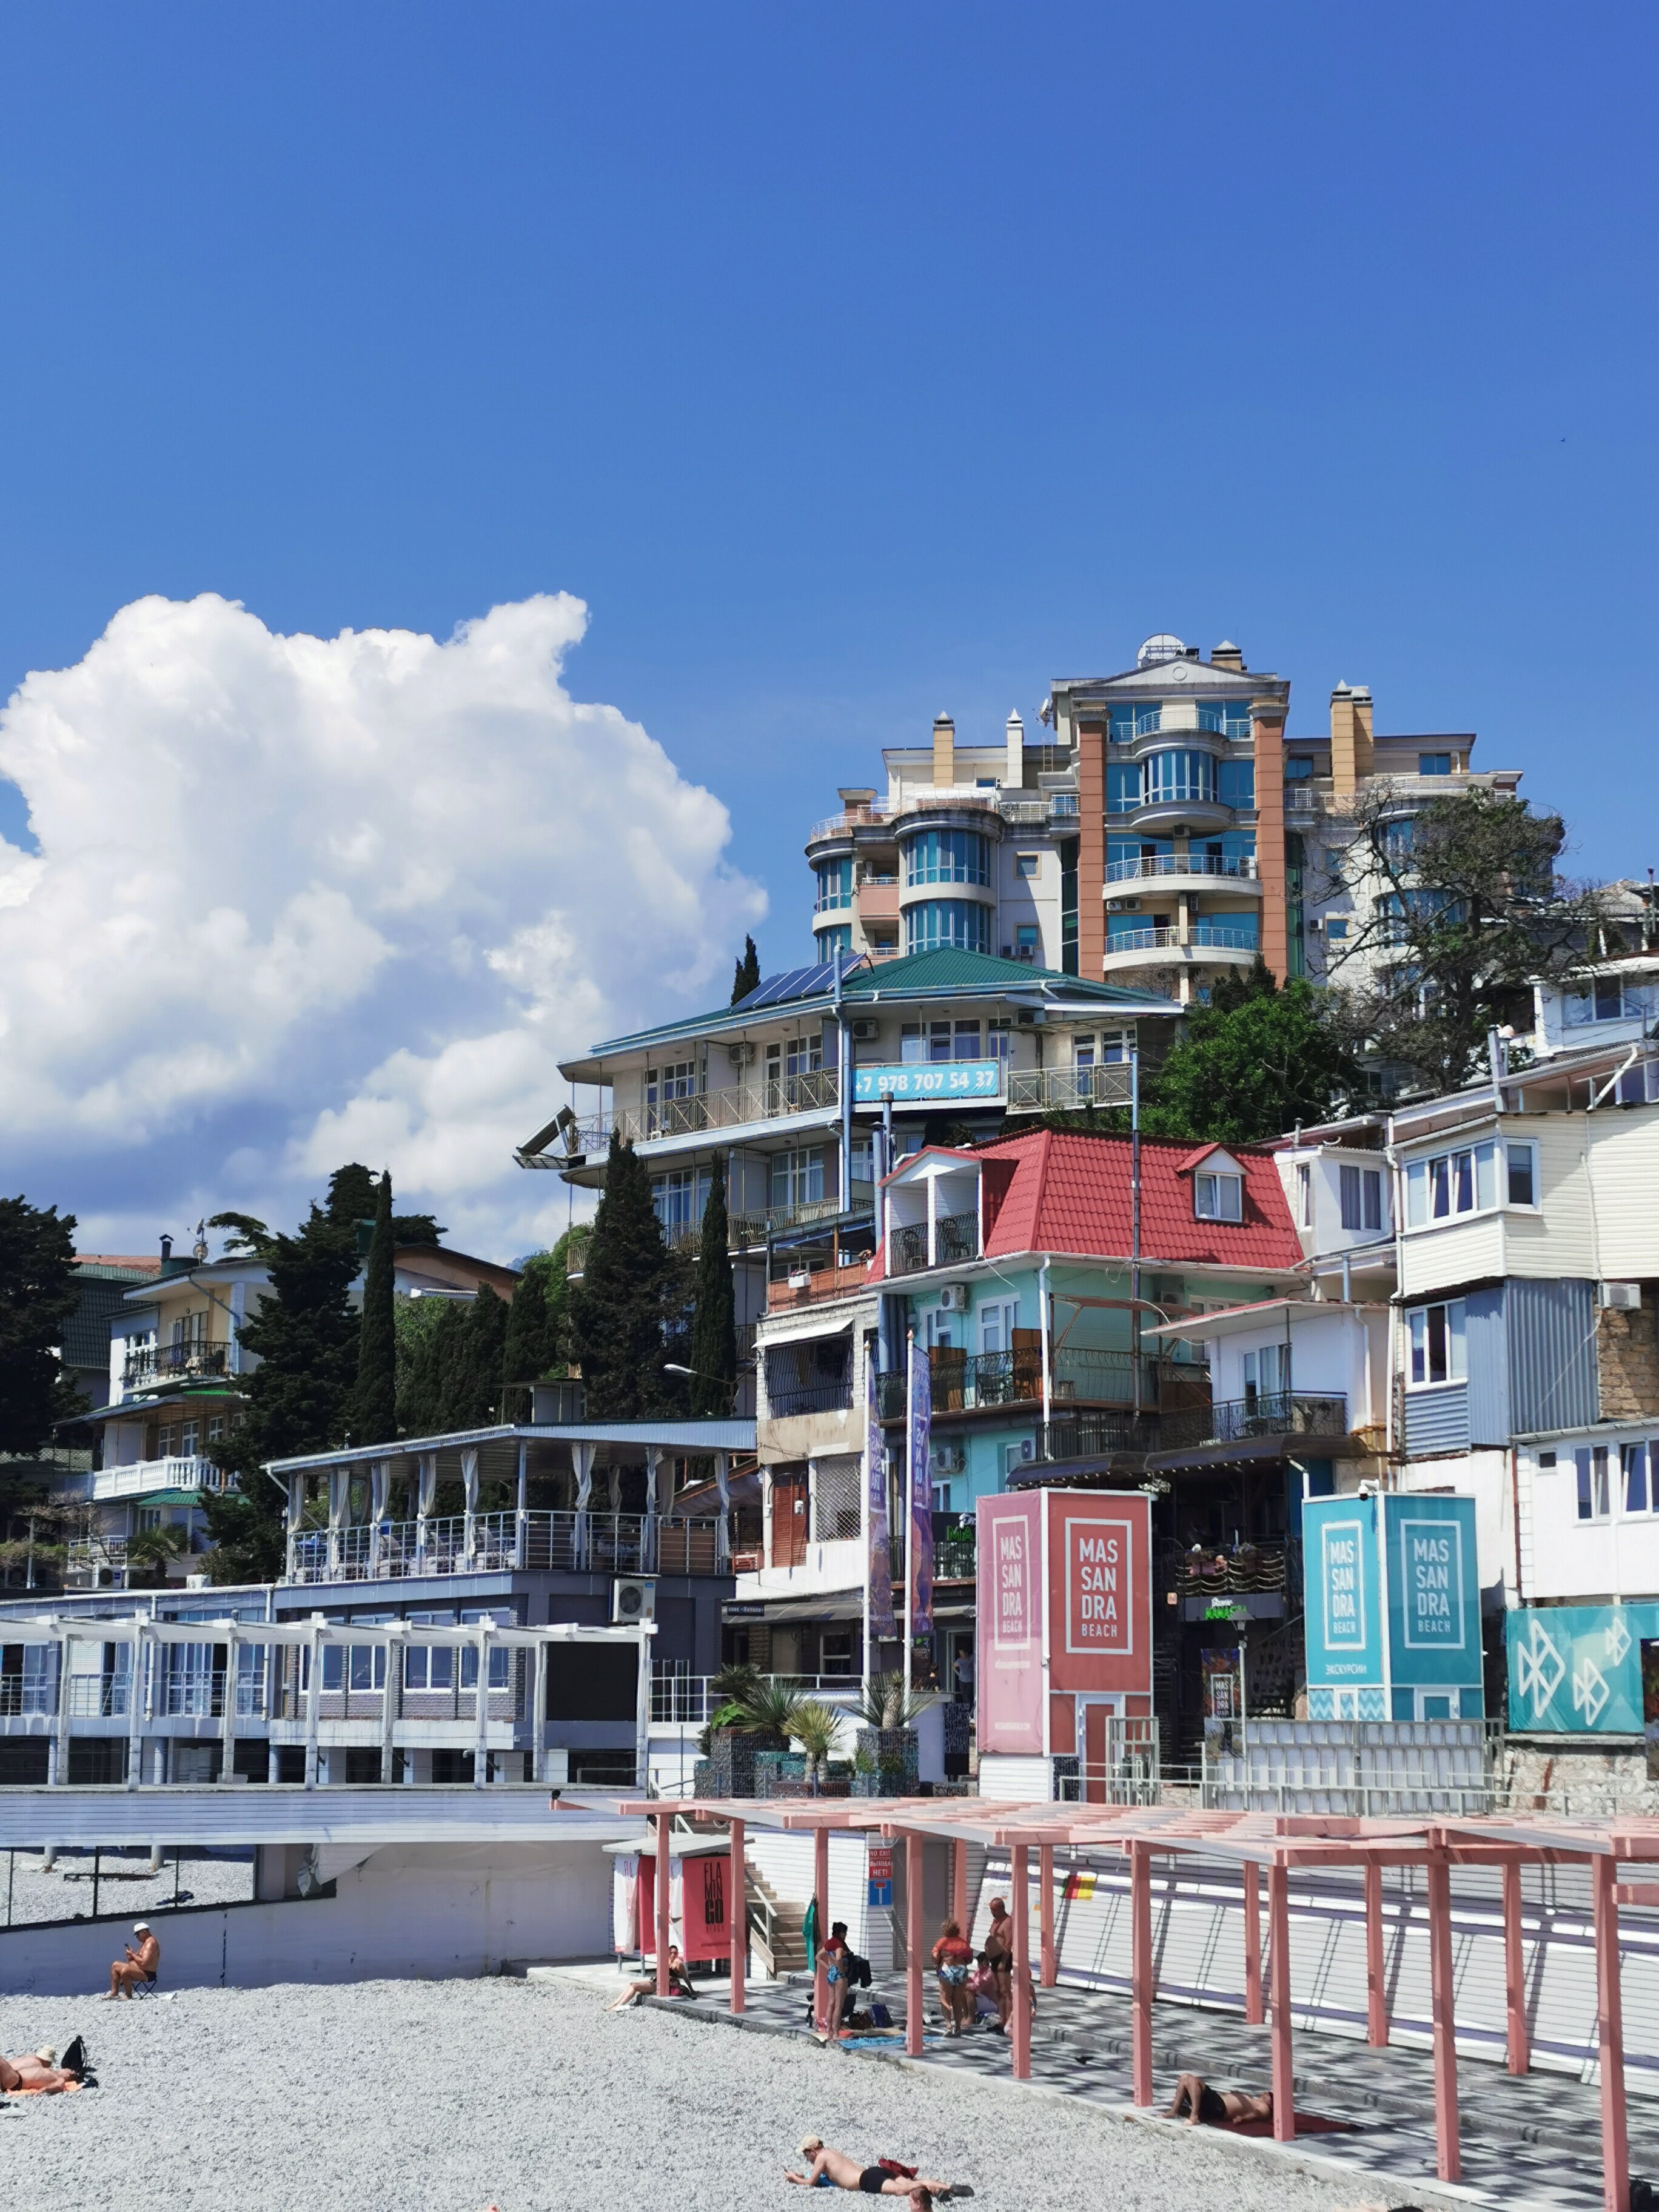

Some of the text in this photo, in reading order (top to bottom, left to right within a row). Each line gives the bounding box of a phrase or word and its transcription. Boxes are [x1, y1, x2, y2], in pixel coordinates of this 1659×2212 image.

[856, 1070, 994, 1092] +7 978 707 54 37
[1000, 1535, 1022, 1561] MAS
[1079, 1538, 1118, 1563] MAS
[1330, 1540, 1354, 1564] MAS
[1413, 1538, 1449, 1563] MAS
[1002, 1563, 1021, 1589] SAN
[1081, 1566, 1116, 1592] SAN
[1332, 1567, 1354, 1590] SAN
[1416, 1566, 1449, 1589] SAN
[1003, 1592, 1022, 1617] DRA
[1081, 1595, 1117, 1620] DRA
[1333, 1594, 1355, 1618] DRA
[1417, 1592, 1450, 1617] DRA
[1003, 1620, 1022, 1634] BEACH
[1082, 1623, 1118, 1637] BEACH
[1334, 1620, 1355, 1634] BEACH
[1418, 1620, 1451, 1633] BEACH
[1326, 1664, 1367, 1675] ЭКСКУРСИИ
[1215, 1681, 1228, 1690] MAS
[1216, 1691, 1228, 1700] SAN
[1216, 1700, 1229, 1709] DRA
[704, 1862, 722, 1882] FLA
[705, 1899, 723, 1924] GO
